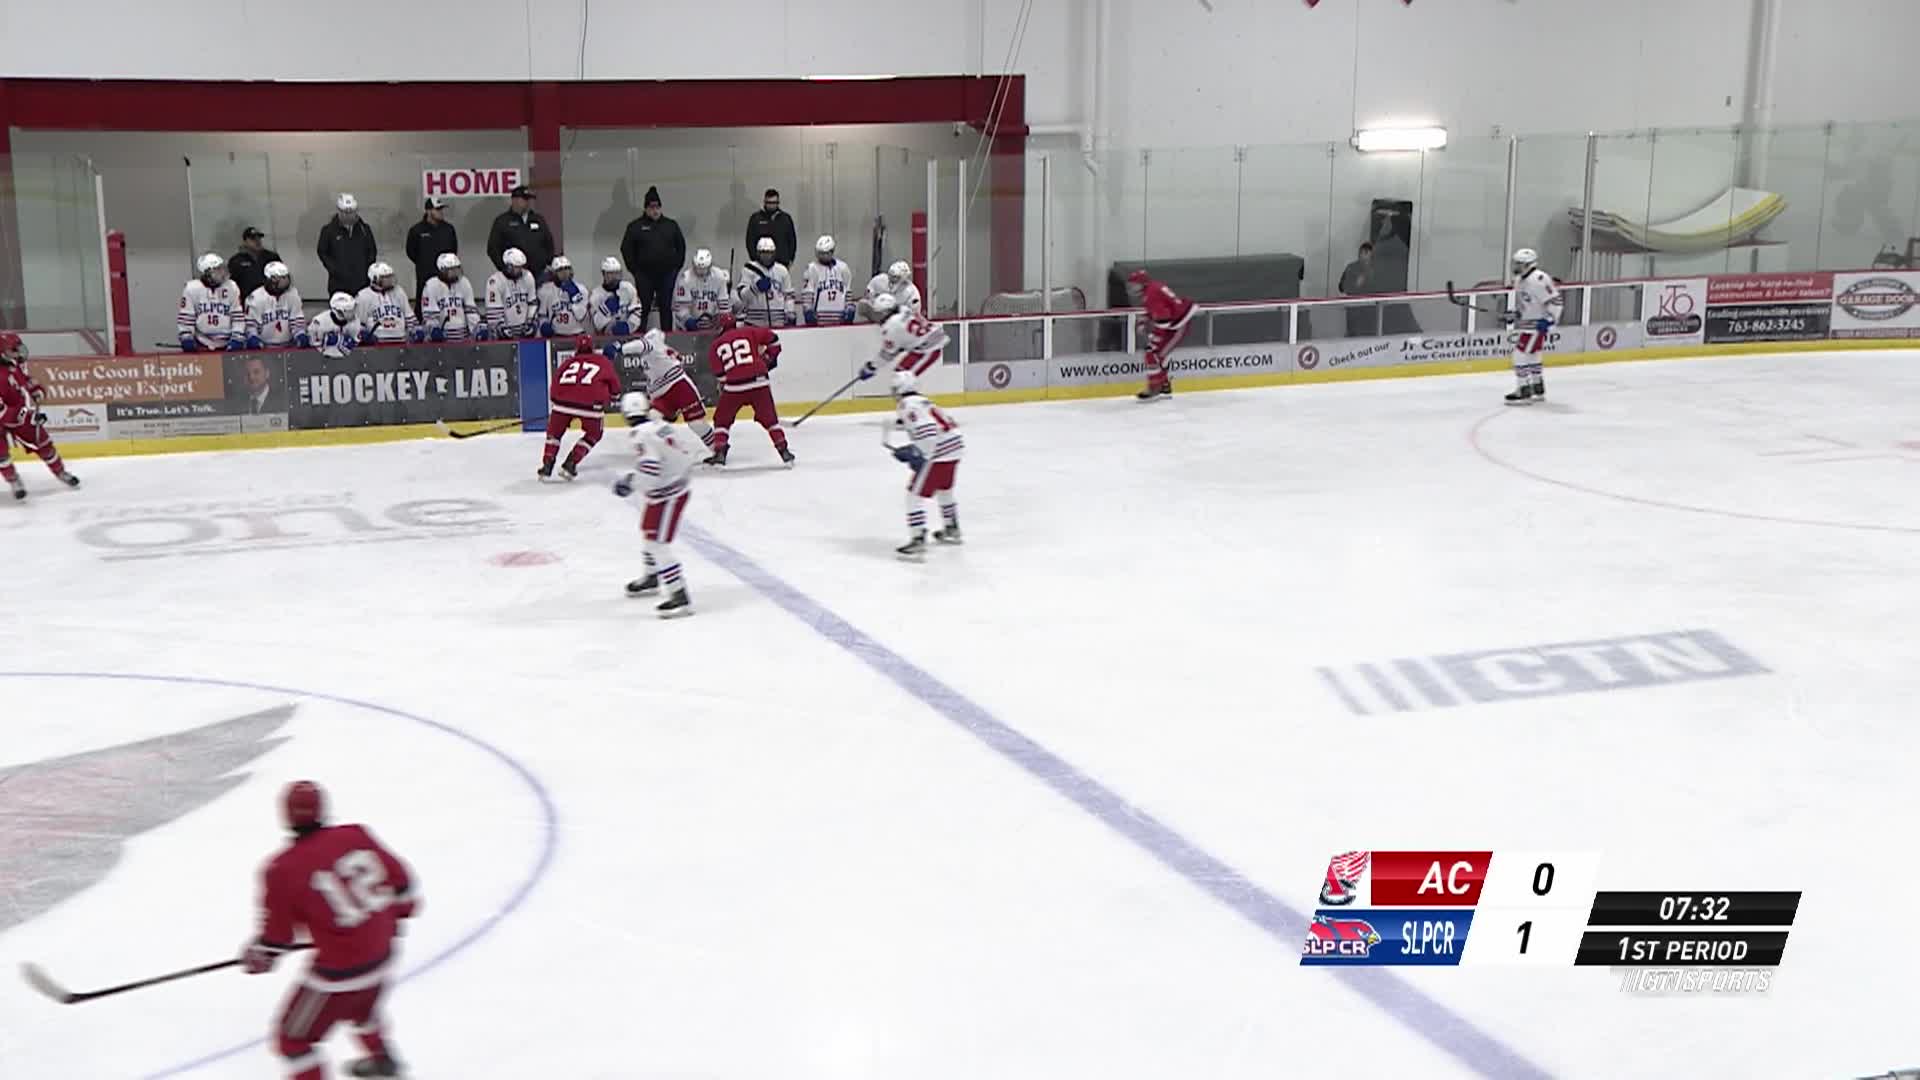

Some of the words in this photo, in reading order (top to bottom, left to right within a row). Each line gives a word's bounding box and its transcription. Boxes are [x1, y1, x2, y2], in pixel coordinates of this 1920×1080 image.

[426, 171, 518, 195] HOME
[828, 291, 837, 301] 17
[1839, 294, 1883, 305] GARAGE
[1728, 318, 1805, 333] 763-862-3245
[1328, 350, 1357, 366] Check
[1359, 347, 1374, 359] out
[1375, 342, 1391, 354] our
[1400, 339, 1416, 352] Jr
[1420, 334, 1501, 350] Cardinal
[717, 338, 754, 371] 22
[46, 366, 89, 382] Your
[93, 364, 138, 381] Coon
[143, 362, 203, 384] Rapids
[559, 361, 601, 385] 27
[47, 382, 132, 401] Mortgage
[136, 379, 195, 401] Expert
[300, 376, 311, 404] THE
[311, 371, 430, 405] HOCKEY
[455, 368, 509, 398] LAB
[116, 407, 134, 417] It's
[135, 406, 162, 416] True.
[164, 404, 190, 415] Let's
[309, 849, 396, 927] 12
